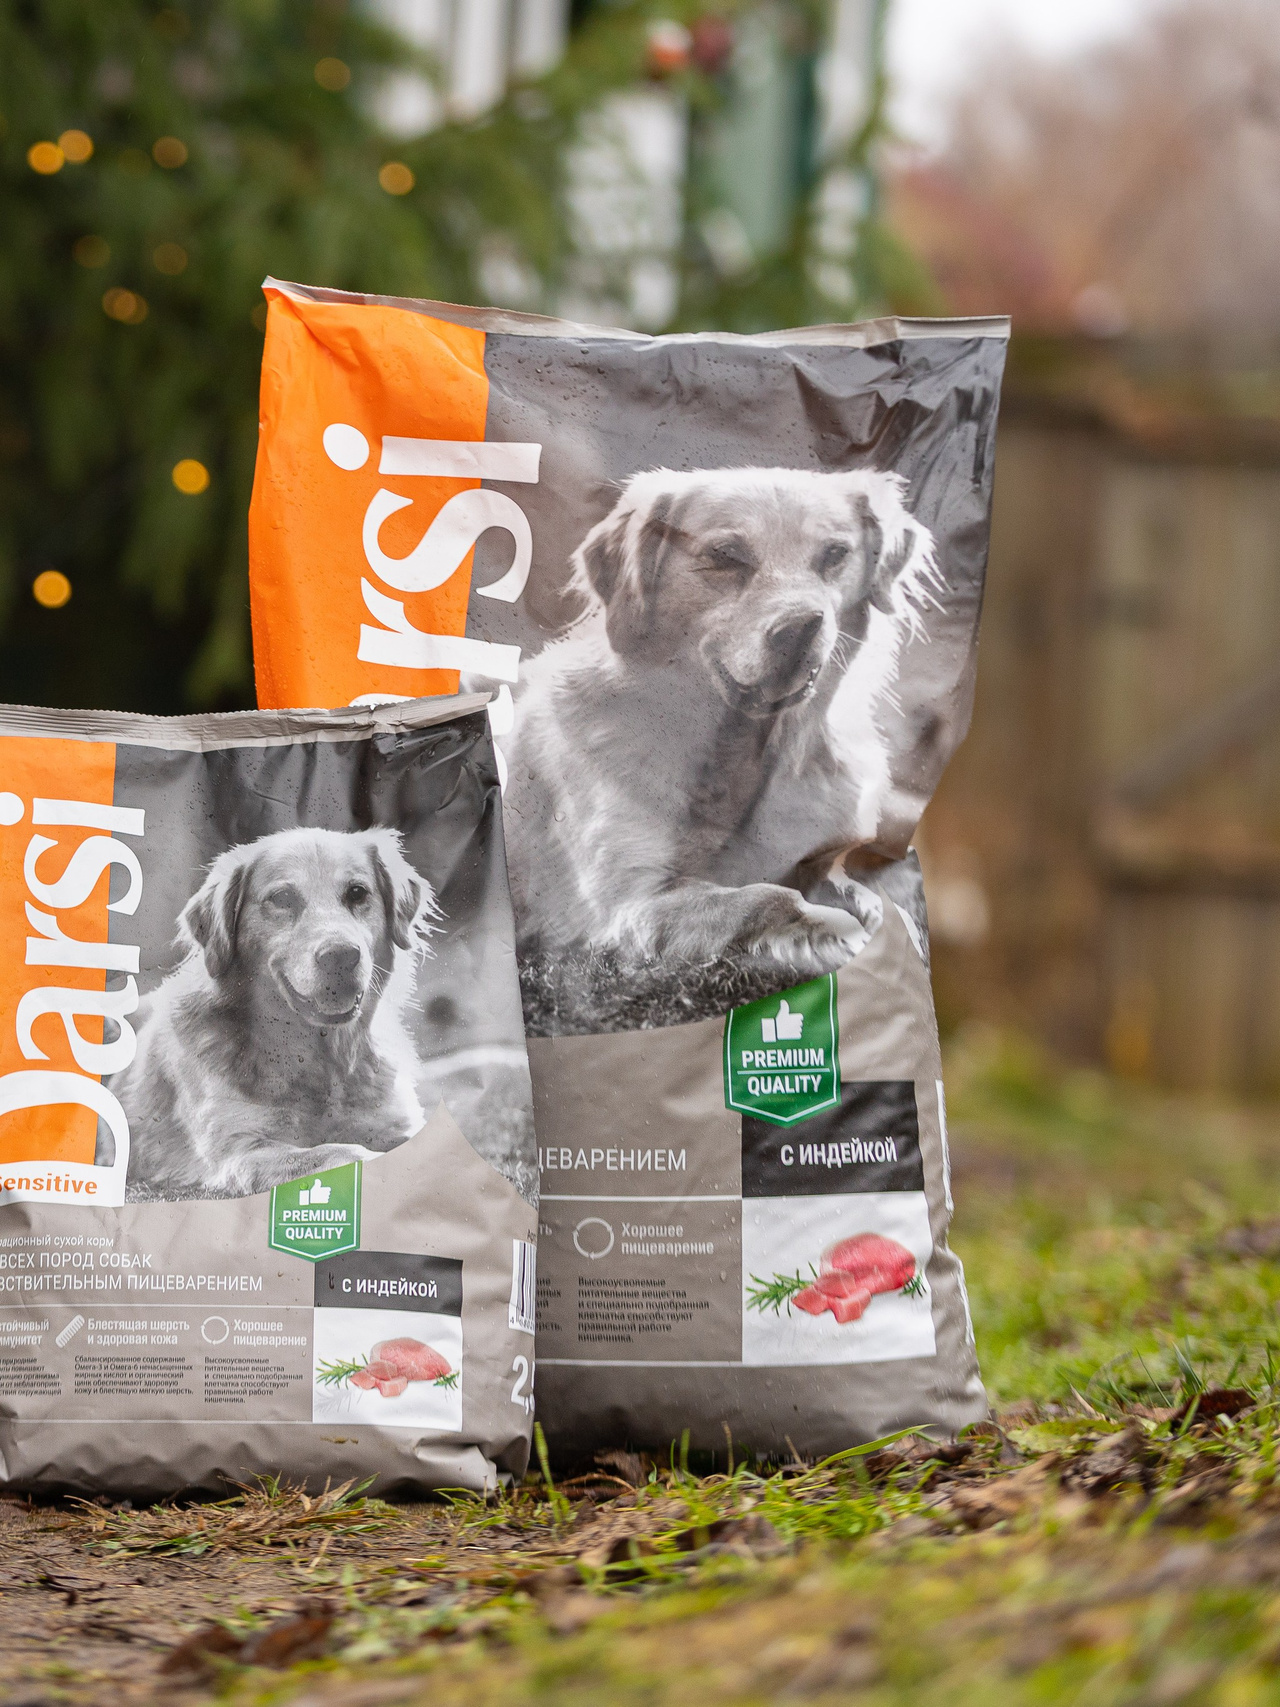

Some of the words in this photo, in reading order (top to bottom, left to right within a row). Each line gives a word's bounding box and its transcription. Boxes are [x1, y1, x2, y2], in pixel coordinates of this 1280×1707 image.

[322, 422, 542, 770] rsi
[741, 1048, 825, 1068] PREMIUM
[747, 1074, 822, 1097] QUALITY
[537, 1147, 687, 1174] ЕВАРЕНИЕМ
[780, 1144, 794, 1166] С
[799, 1136, 898, 1169] ИНДЕЙКОЙ
[282, 1209, 347, 1222] PREMIUM
[285, 1227, 344, 1240] QUALITY
[621, 1222, 684, 1240] Хорошее
[54, 1235, 84, 1248] сухой
[86, 1237, 114, 1248] корм
[621, 1241, 714, 1258] пищеварение
[0, 1252, 35, 1269] ВСЕХ
[40, 1252, 94, 1270] ПОРОД
[98, 1252, 152, 1268] СОБАК
[127, 1275, 263, 1293] ПИЩЕВАРЕНИЕМ
[342, 1278, 352, 1292] С
[356, 1277, 438, 1298] ИНДЕЙКОЙ
[87, 1318, 148, 1333] Блестящая
[150, 1320, 190, 1333] шерсть
[233, 1319, 283, 1333] Хорошее
[87, 1335, 94, 1344] и
[96, 1334, 148, 1346] здоровая
[150, 1335, 178, 1345] кожа
[233, 1334, 307, 1347] пищеварение
